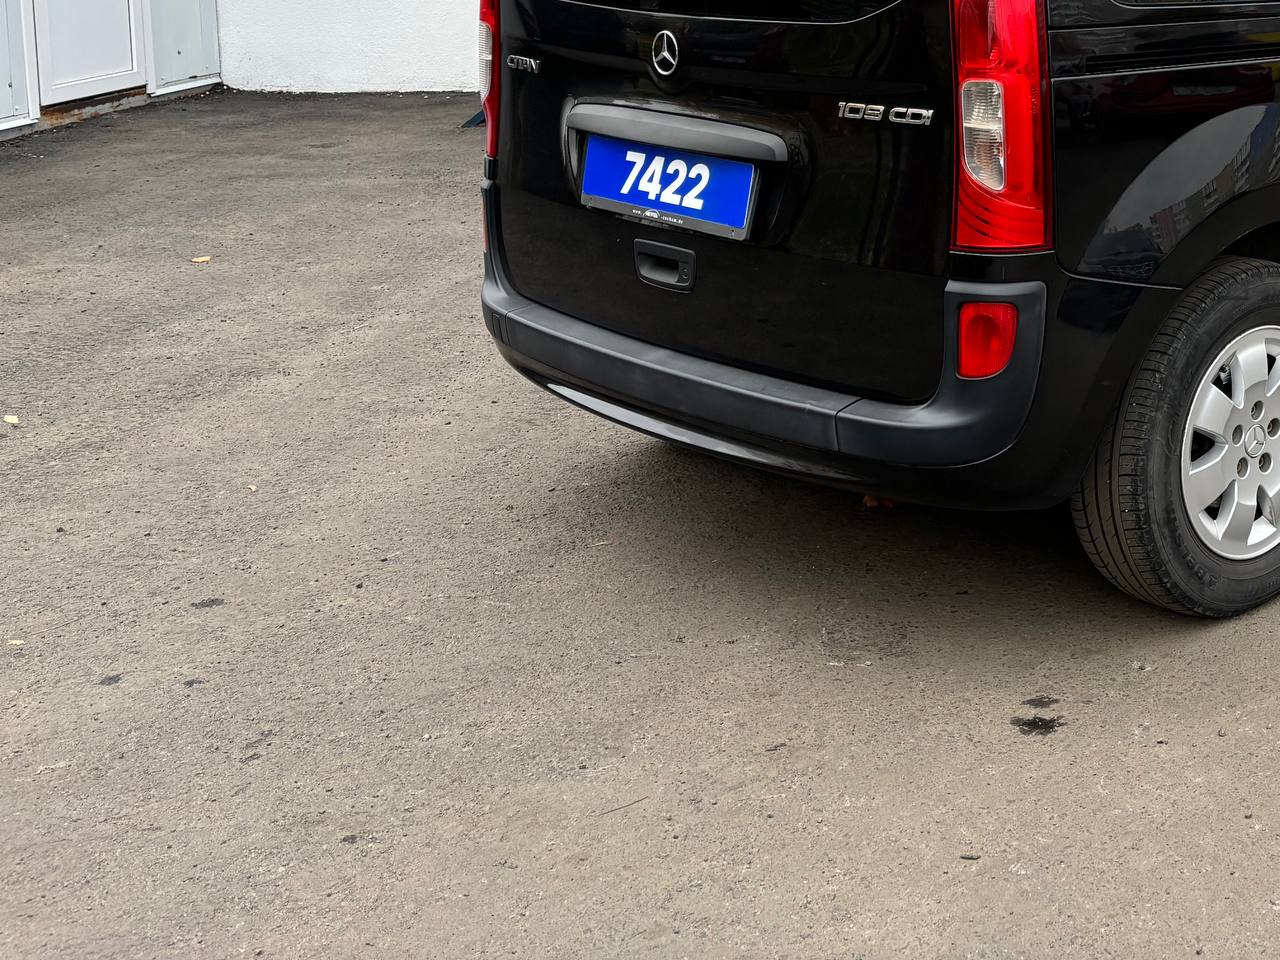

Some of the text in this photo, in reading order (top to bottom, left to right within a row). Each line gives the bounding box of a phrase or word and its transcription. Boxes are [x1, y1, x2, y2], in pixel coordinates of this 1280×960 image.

[838, 101, 934, 126] 109 CDI
[619, 150, 711, 210] 7422
